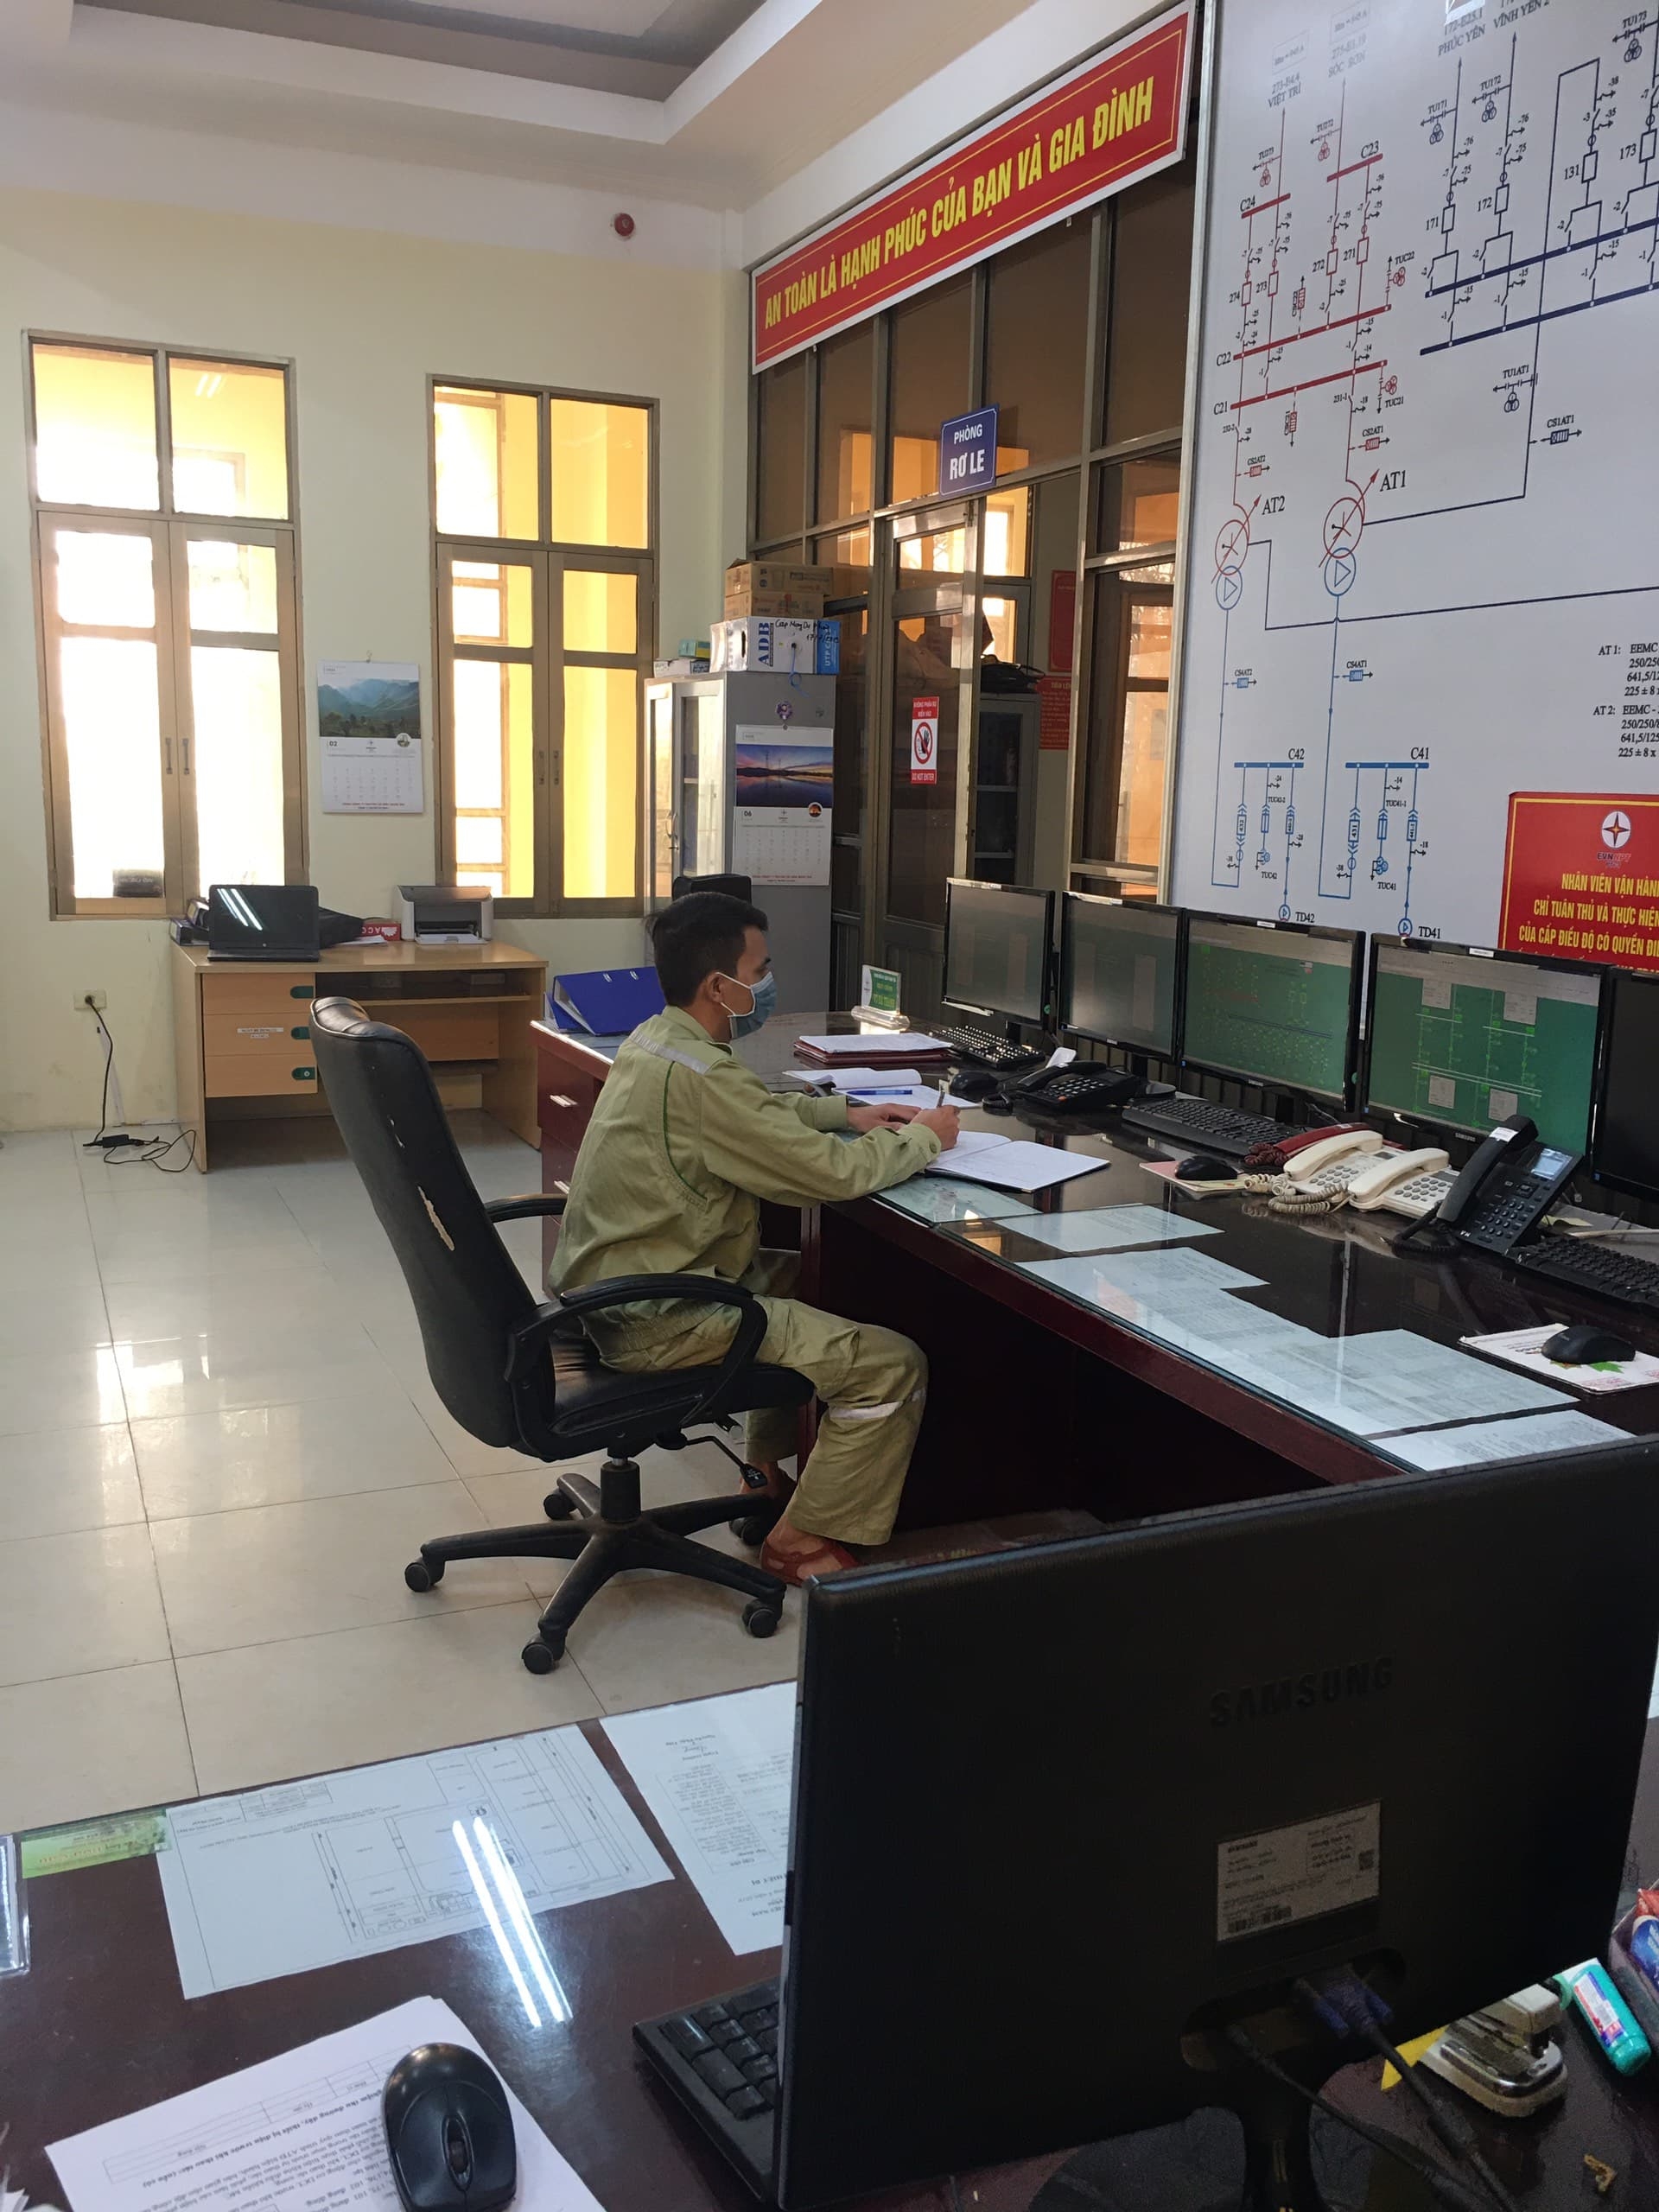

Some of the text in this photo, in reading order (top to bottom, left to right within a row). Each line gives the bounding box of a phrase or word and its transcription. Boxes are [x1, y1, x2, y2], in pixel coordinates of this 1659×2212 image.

[1493, 10, 1519, 29] VĨNH
[1623, 10, 1647, 29] TU173
[1465, 24, 1485, 44] YÊN
[1480, 75, 1502, 91] TU172
[1428, 99, 1447, 114] TU171
[1361, 140, 1380, 159] C23
[1619, 143, 1637, 160] 173
[1564, 164, 1580, 181] 131
[765, 75, 1155, 330] AN TOÀN LÀ HẠNH PHÚC CỦA BẠN VÀ GIA ĐÌNH
[1240, 195, 1256, 212] C24
[1478, 197, 1492, 212] 172
[1426, 217, 1439, 231] 171
[1344, 247, 1356, 261] 271
[1313, 259, 1325, 273] 272
[1256, 279, 1268, 293] 273
[1229, 291, 1241, 303] 274
[1217, 352, 1231, 366] C22
[1214, 401, 1229, 416] C21
[953, 423, 983, 445] PHÒNG
[949, 448, 985, 480] RƠ LE
[1380, 470, 1407, 493] AT1
[1262, 495, 1286, 515] AT2
[758, 622, 769, 666] ADB
[1599, 645, 1611, 656] AT
[1630, 643, 1659, 653] EEMC
[1624, 686, 1640, 696] 225
[1649, 686, 1655, 695] 8
[1593, 706, 1606, 715] AT
[1623, 704, 1650, 715] EEMC
[1288, 748, 1305, 760] C42
[1411, 747, 1430, 760] C41
[1618, 748, 1633, 757] 225
[1643, 747, 1649, 757] 8
[1562, 871, 1588, 892] NHÂN
[1590, 873, 1611, 893] VIÊN
[1615, 874, 1634, 899] VẬN
[1295, 912, 1315, 923] TD42
[1534, 894, 1549, 916] CHỈ
[1551, 899, 1574, 918] TUÂN
[1578, 899, 1594, 921] THỦ
[1597, 902, 1608, 923] VÀ
[1611, 904, 1636, 928] THỰC
[1418, 925, 1441, 939] TD41
[1519, 920, 1536, 943] CỦA
[1539, 922, 1556, 944] CẤP
[1581, 930, 1594, 953] ĐỘ
[1597, 931, 1609, 951] CÓ
[1455, 1133, 1476, 1141] SAMSUNG
[1211, 1656, 1394, 1727] SAMSUNG
